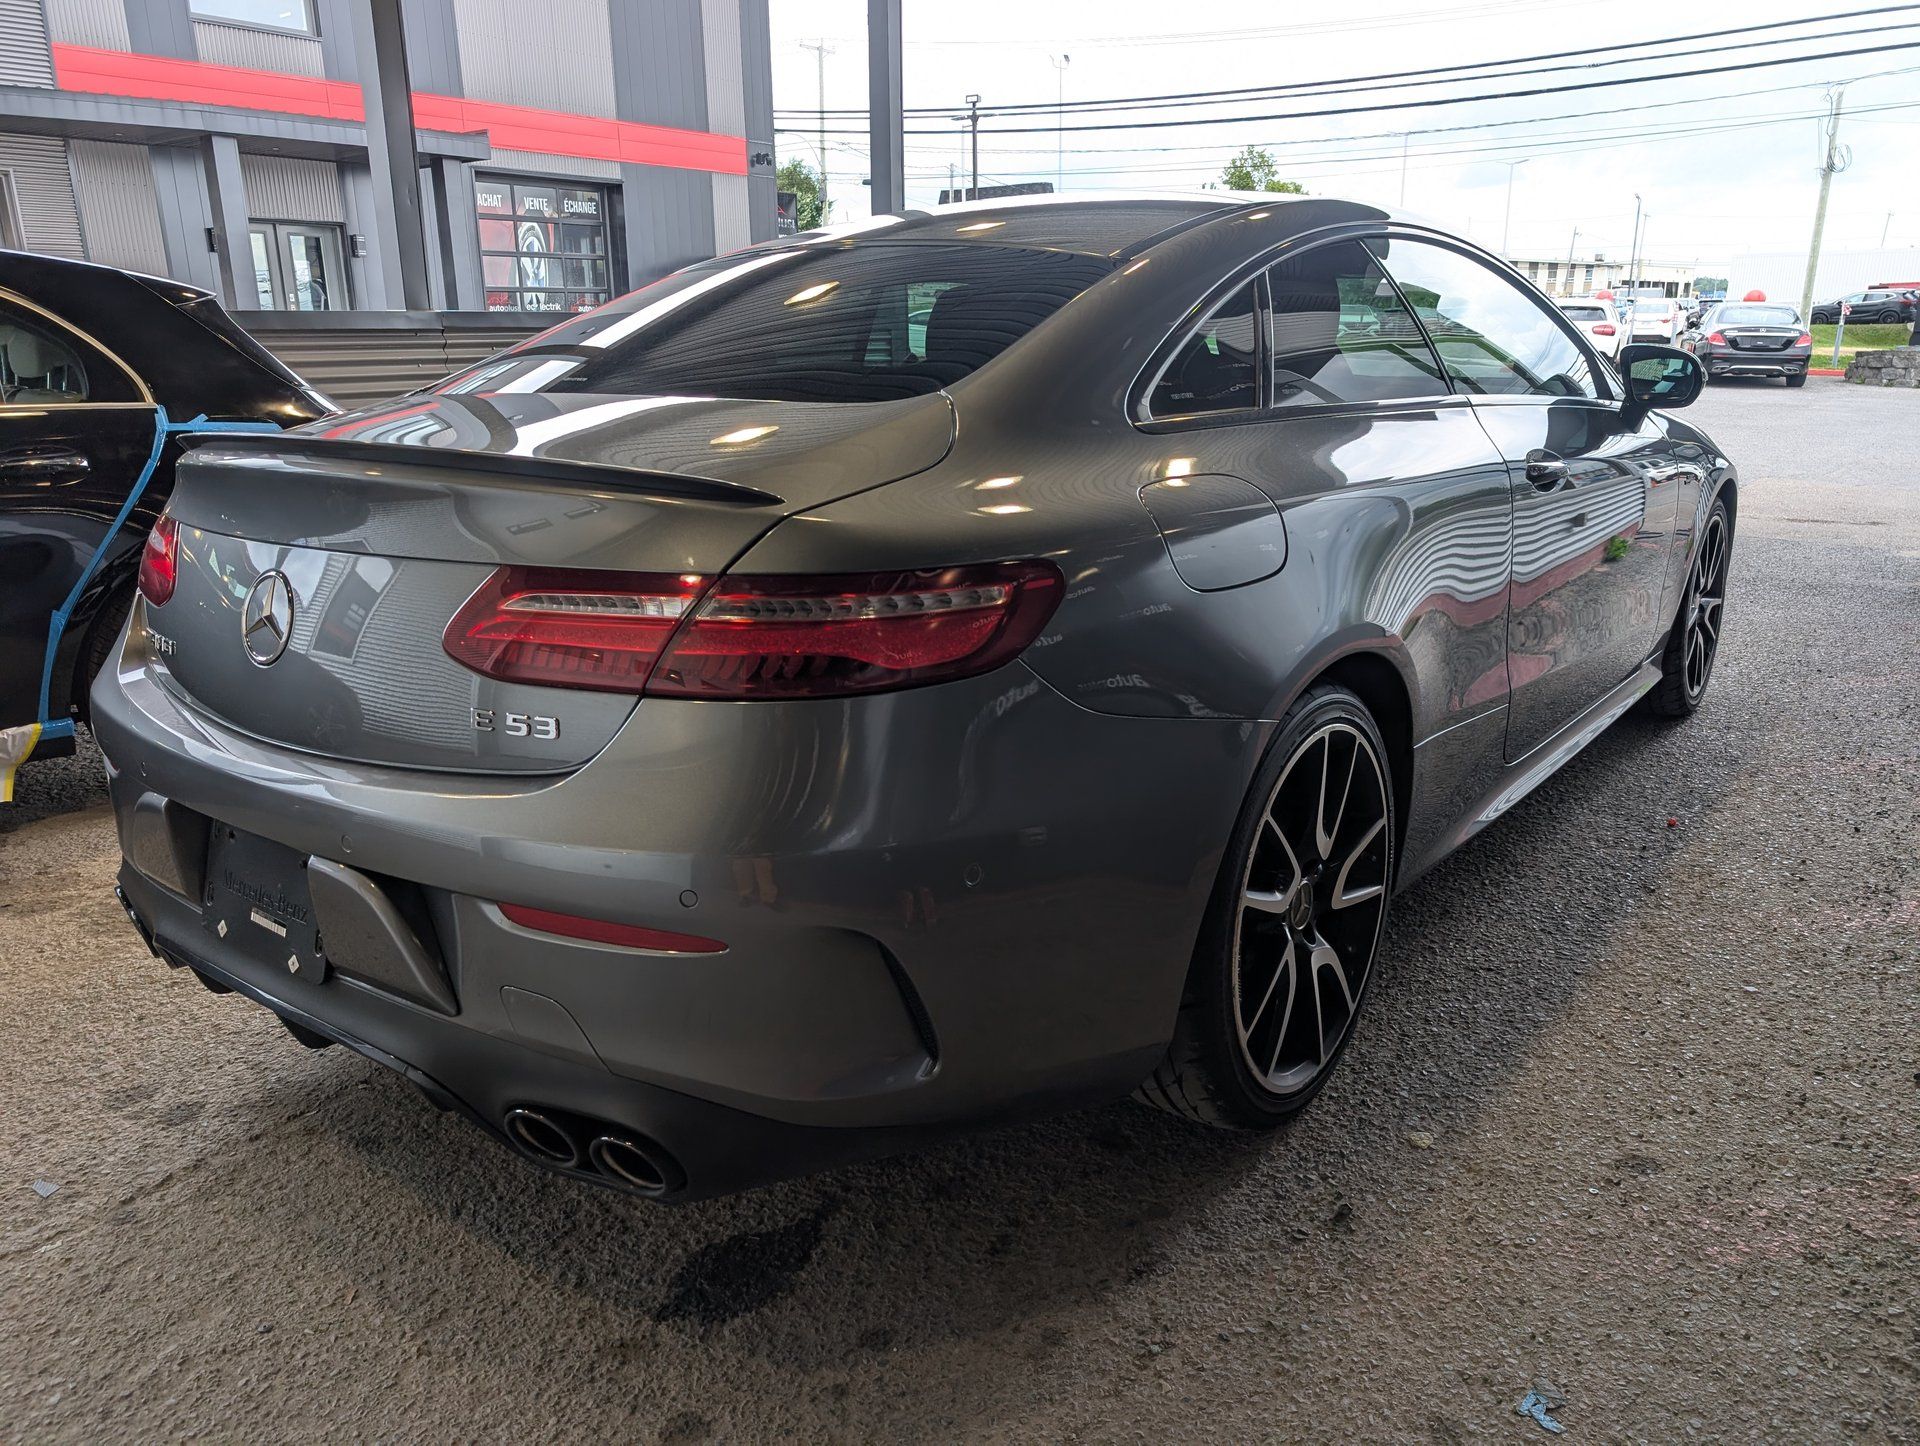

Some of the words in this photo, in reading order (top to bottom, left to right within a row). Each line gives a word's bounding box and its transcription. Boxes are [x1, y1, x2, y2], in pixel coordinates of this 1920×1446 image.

[477, 193, 502, 208] ACHAT
[523, 196, 549, 211] VENTE
[563, 197, 597, 214] ÉCHANGE
[471, 707, 495, 732] E
[505, 712, 560, 740] 53
